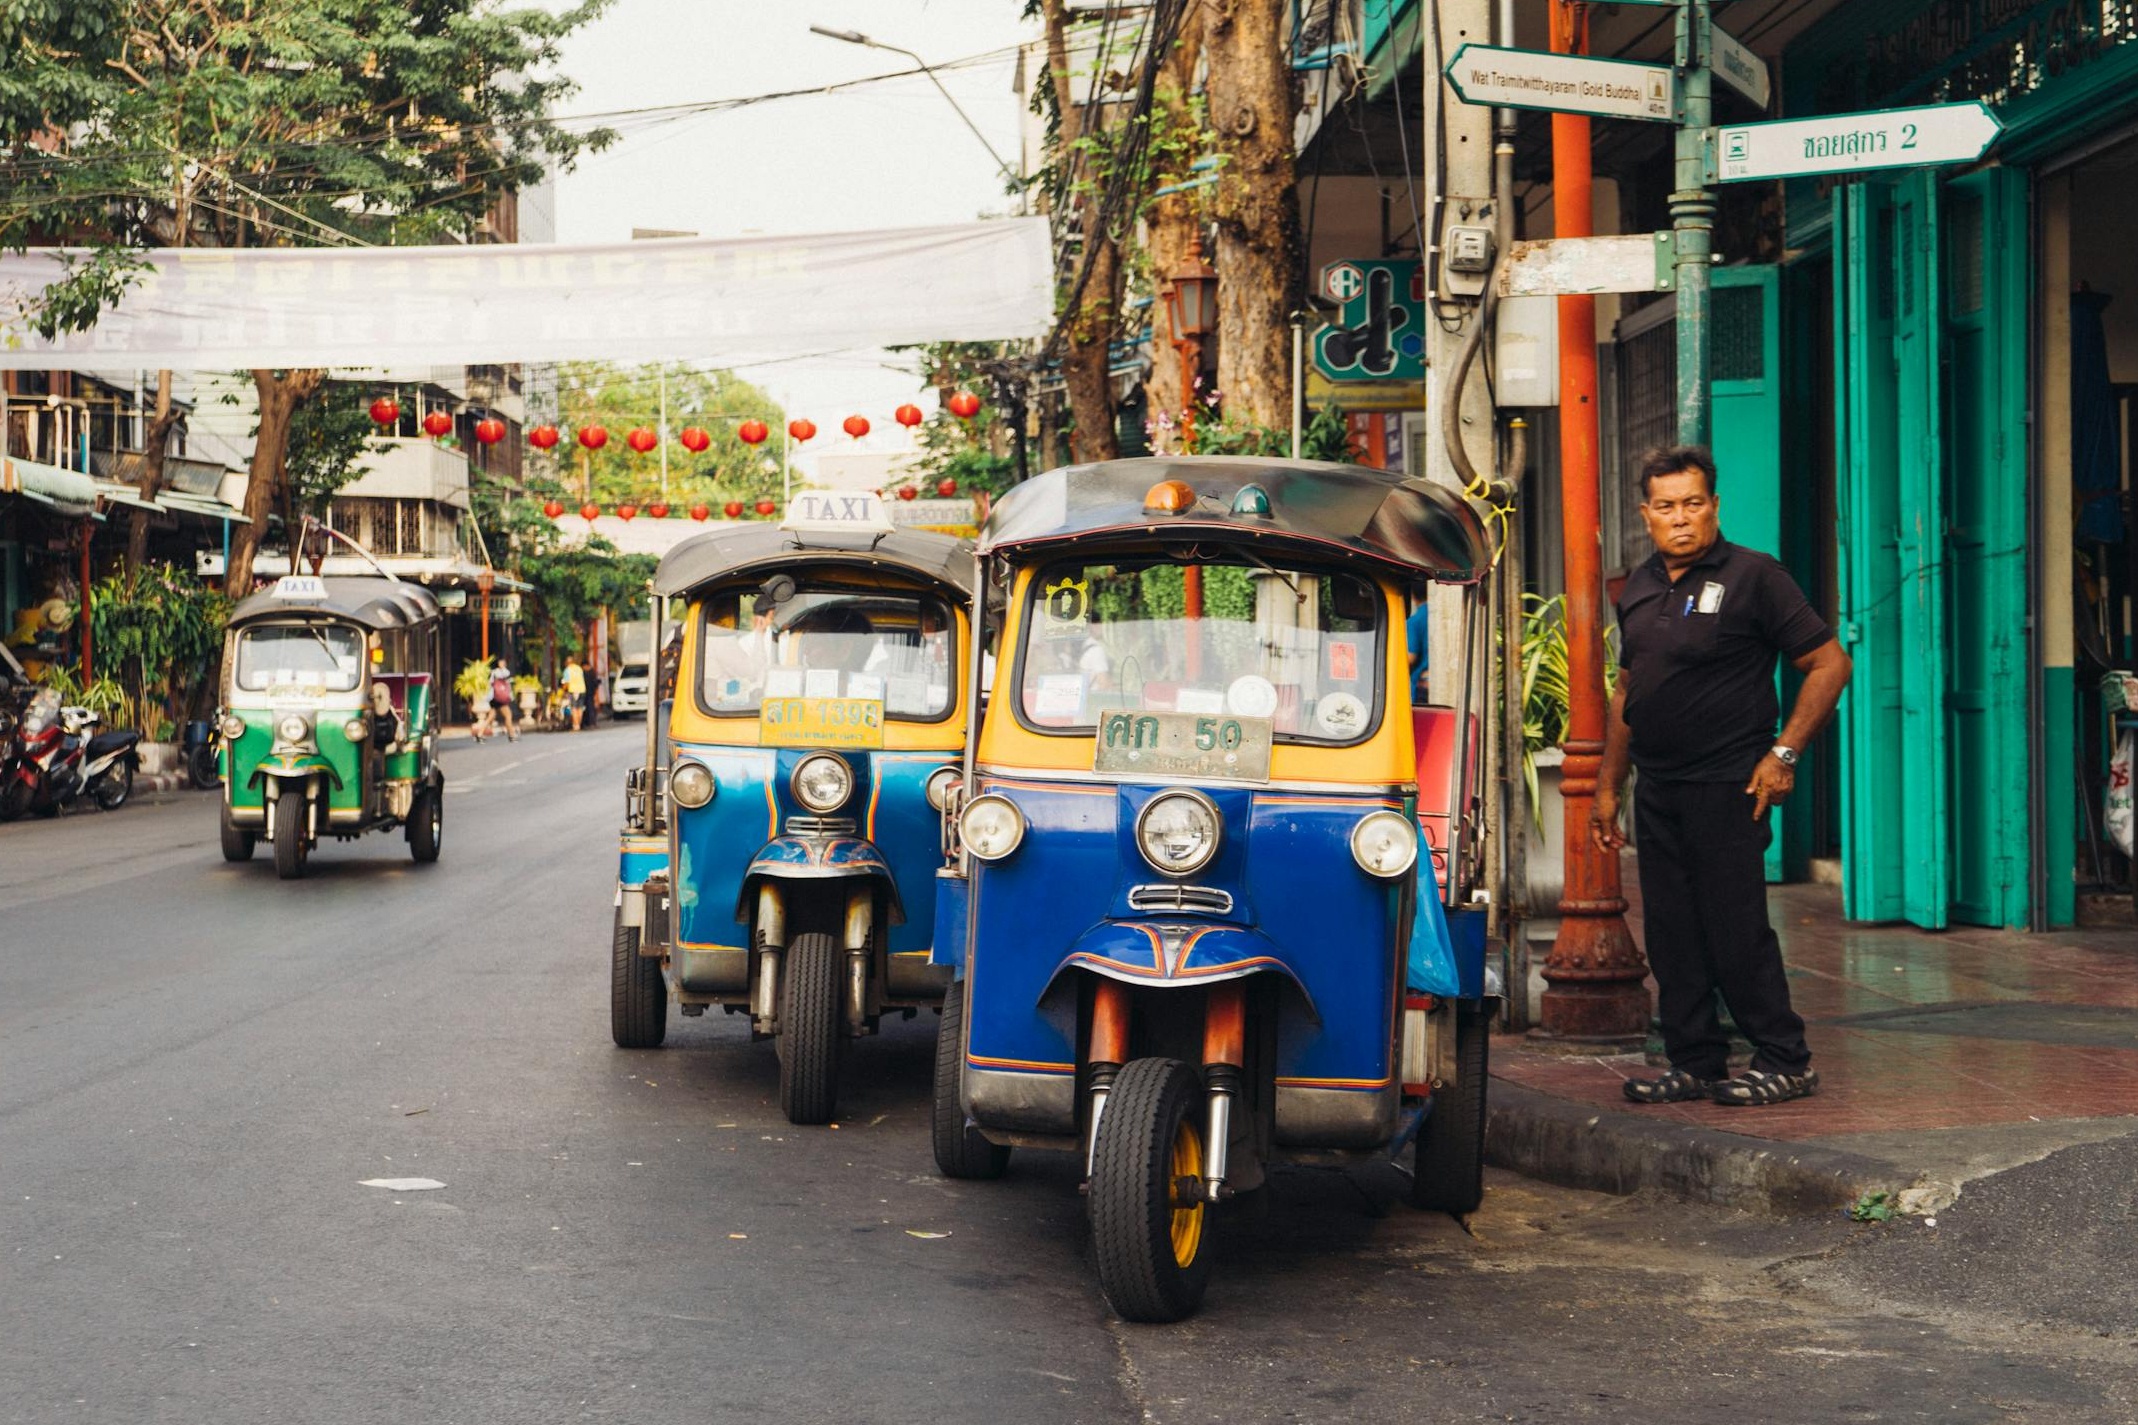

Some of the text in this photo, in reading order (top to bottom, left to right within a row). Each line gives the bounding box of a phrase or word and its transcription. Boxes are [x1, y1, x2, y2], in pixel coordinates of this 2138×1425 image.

[1471, 69, 1488, 86] Wat
[1580, 80, 1603, 98] (Gold
[1605, 83, 1642, 104] Buddha)
[1803, 123, 1918, 161] ซอยสุกร 2
[802, 497, 871, 522] TAXI
[282, 580, 316, 592] TAXI
[817, 701, 878, 728] 1398
[1195, 716, 1243, 751] 50
